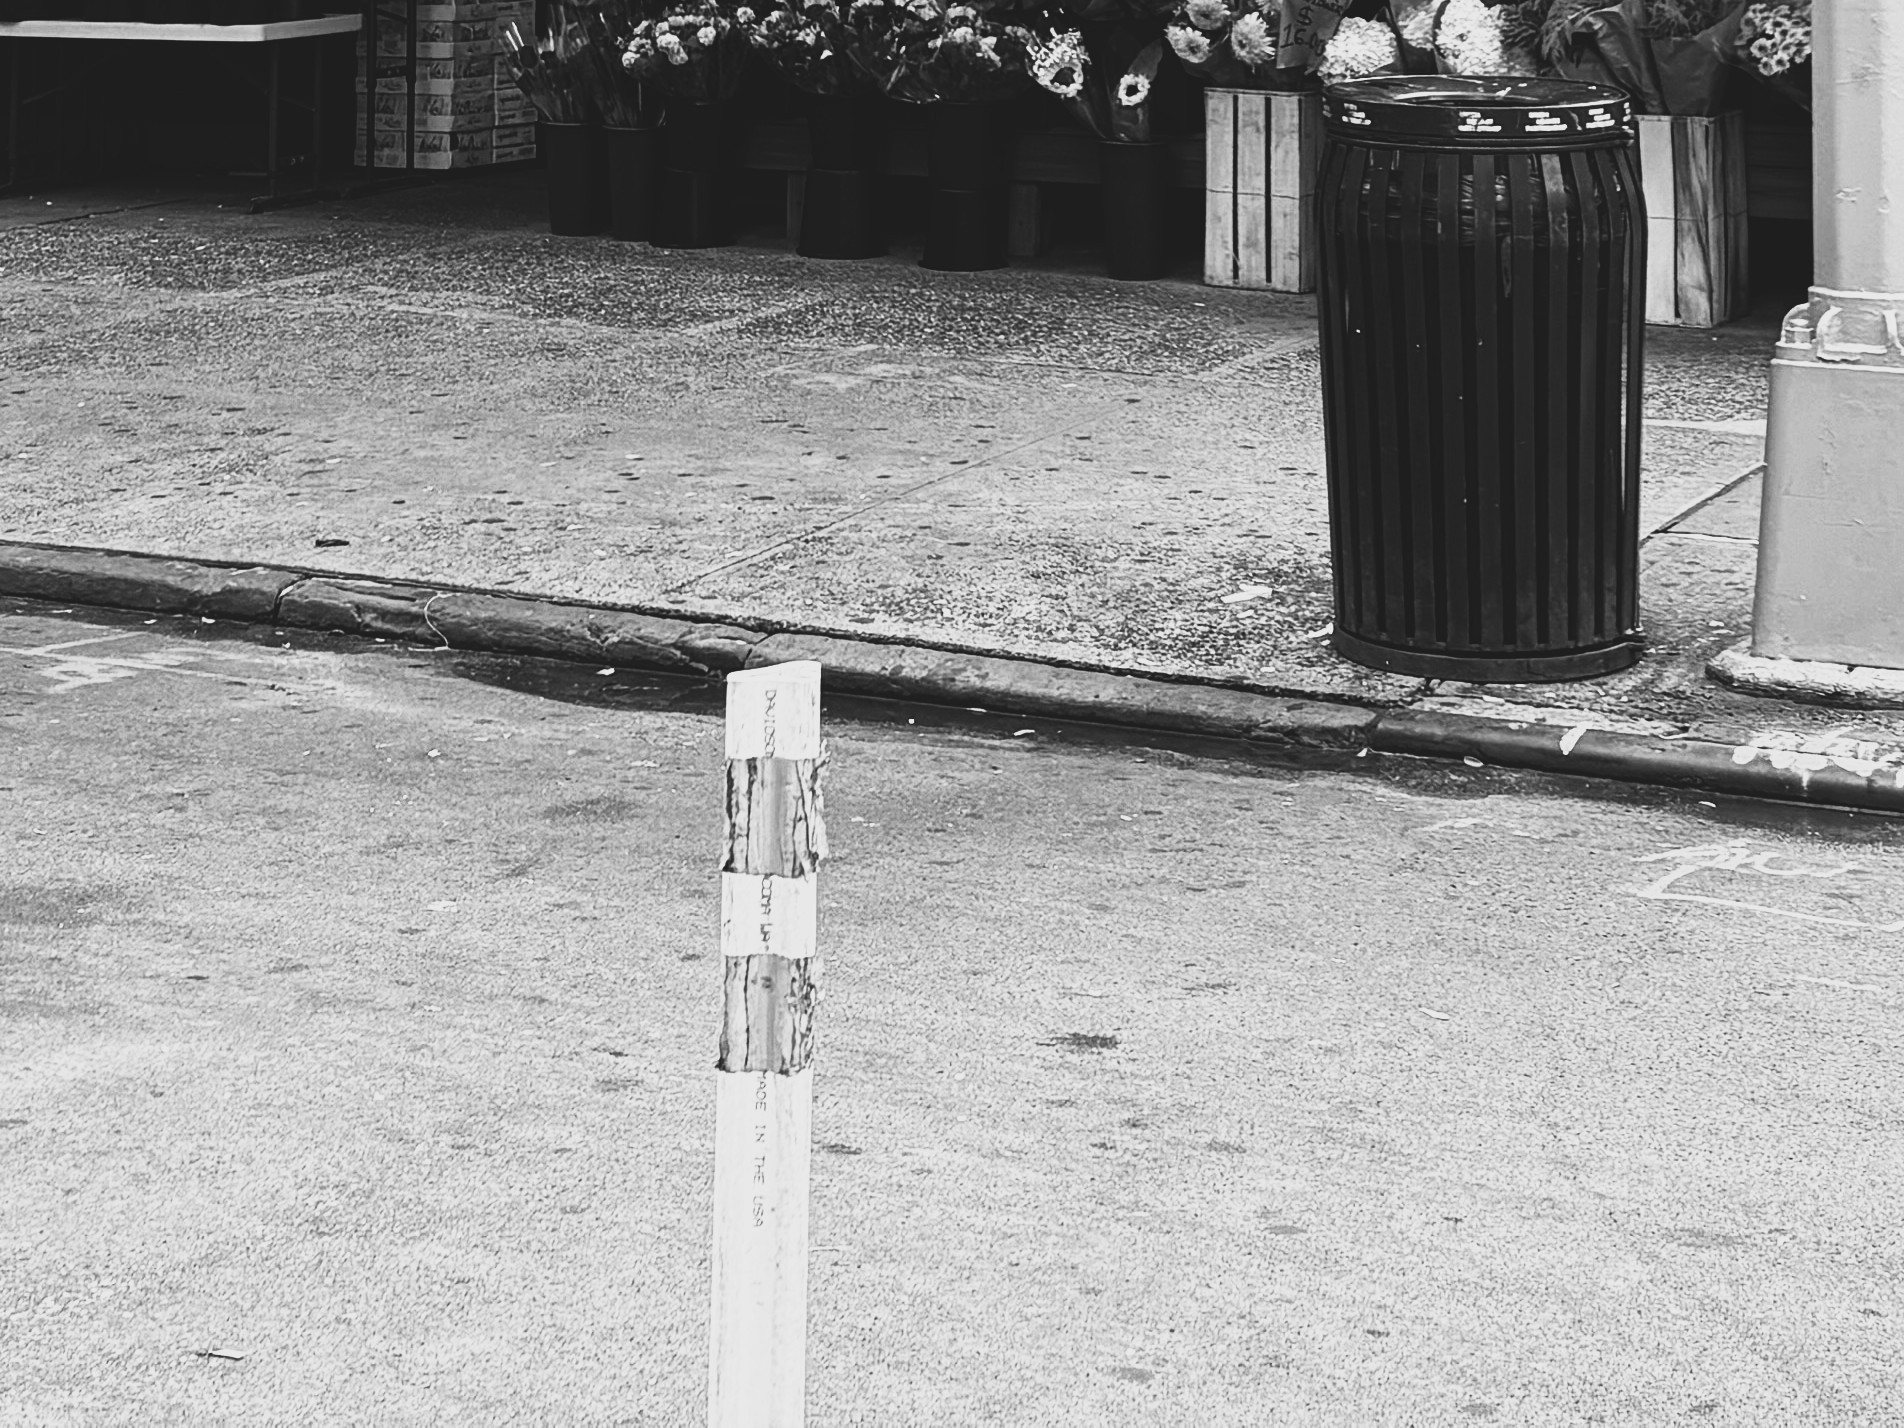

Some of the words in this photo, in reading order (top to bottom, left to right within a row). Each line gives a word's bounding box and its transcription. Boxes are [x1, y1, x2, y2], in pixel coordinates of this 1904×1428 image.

[1296, 5, 1313, 26] $
[760, 877, 772, 915] COMA
[754, 1124, 766, 1143] IN
[752, 1155, 765, 1185] THE
[751, 1195, 763, 1228] USA
